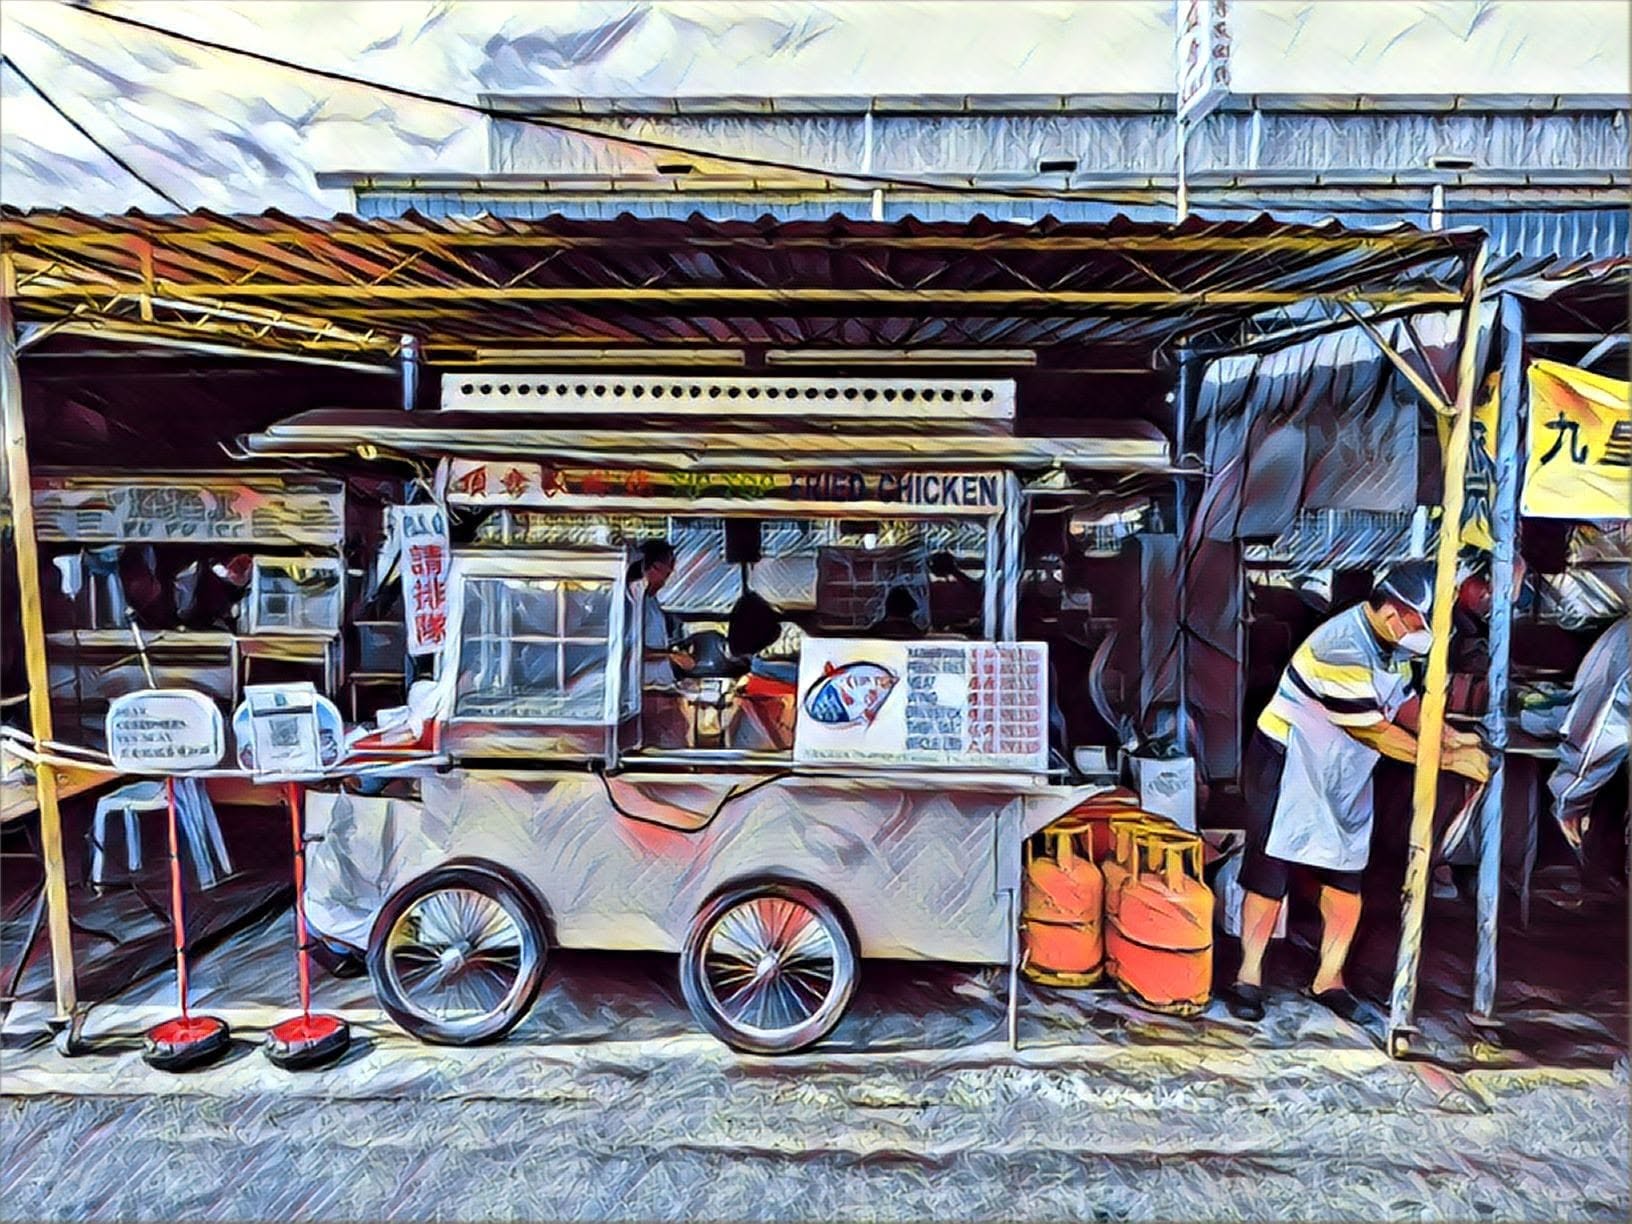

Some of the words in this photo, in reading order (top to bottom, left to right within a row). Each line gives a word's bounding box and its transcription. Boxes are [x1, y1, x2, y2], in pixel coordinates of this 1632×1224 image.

[880, 473, 996, 506] CHICKEN
[409, 544, 446, 646] 請排隊
